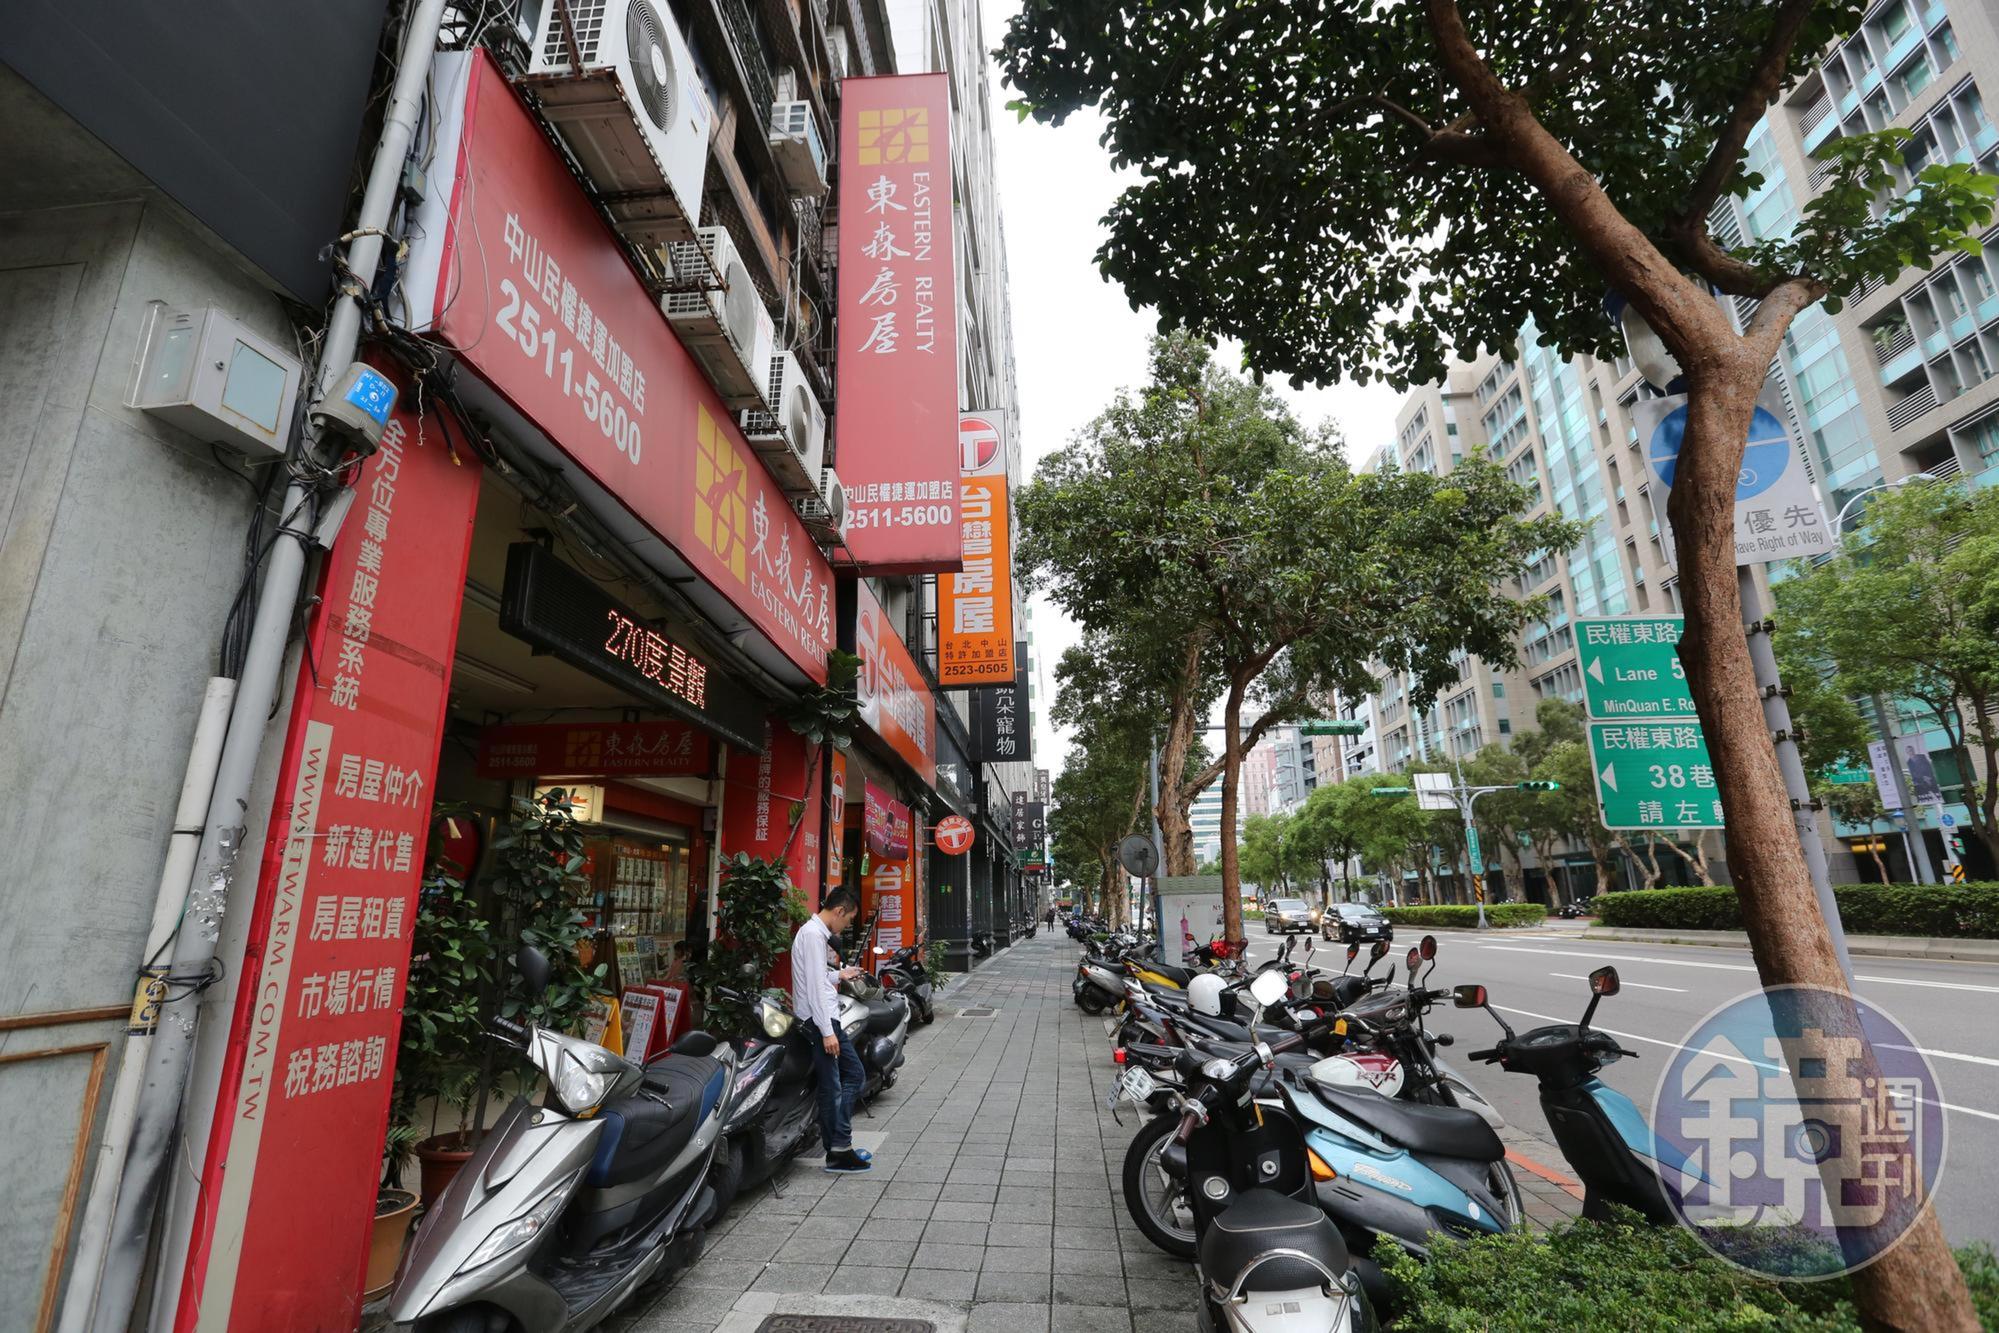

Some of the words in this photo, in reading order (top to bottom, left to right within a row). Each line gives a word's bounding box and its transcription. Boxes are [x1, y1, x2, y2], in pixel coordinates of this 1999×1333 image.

[913, 171, 932, 262] EASTERN
[858, 174, 911, 354] 東森房屋
[503, 212, 647, 417] 中山民權捷運加盟店
[915, 275, 934, 354] REALTY
[496, 279, 642, 466] 2511-5600
[844, 480, 953, 503] 中山民權捷運加盟店
[847, 505, 952, 529] 2511-5600
[1744, 504, 1817, 535] 優先
[1757, 536, 1786, 552] Right
[1788, 532, 1797, 546] of
[1800, 531, 1824, 545] Way
[329, 418, 407, 711] 全方位專業服務系統
[751, 489, 830, 644] 東森房屋
[751, 570, 799, 641] EASTERN
[945, 664, 1008, 676] 2523-0505
[1615, 667, 1658, 682] Lane
[1604, 699, 1660, 714] MinQuan
[1662, 698, 1676, 712] E.
[603, 757, 650, 768] EASTERN
[605, 730, 693, 756] 東森房屋
[334, 753, 424, 809] 房屋仲介
[322, 823, 415, 873] 新建代售
[309, 895, 406, 942] 房屋租賃
[297, 966, 397, 1020] 市場行情
